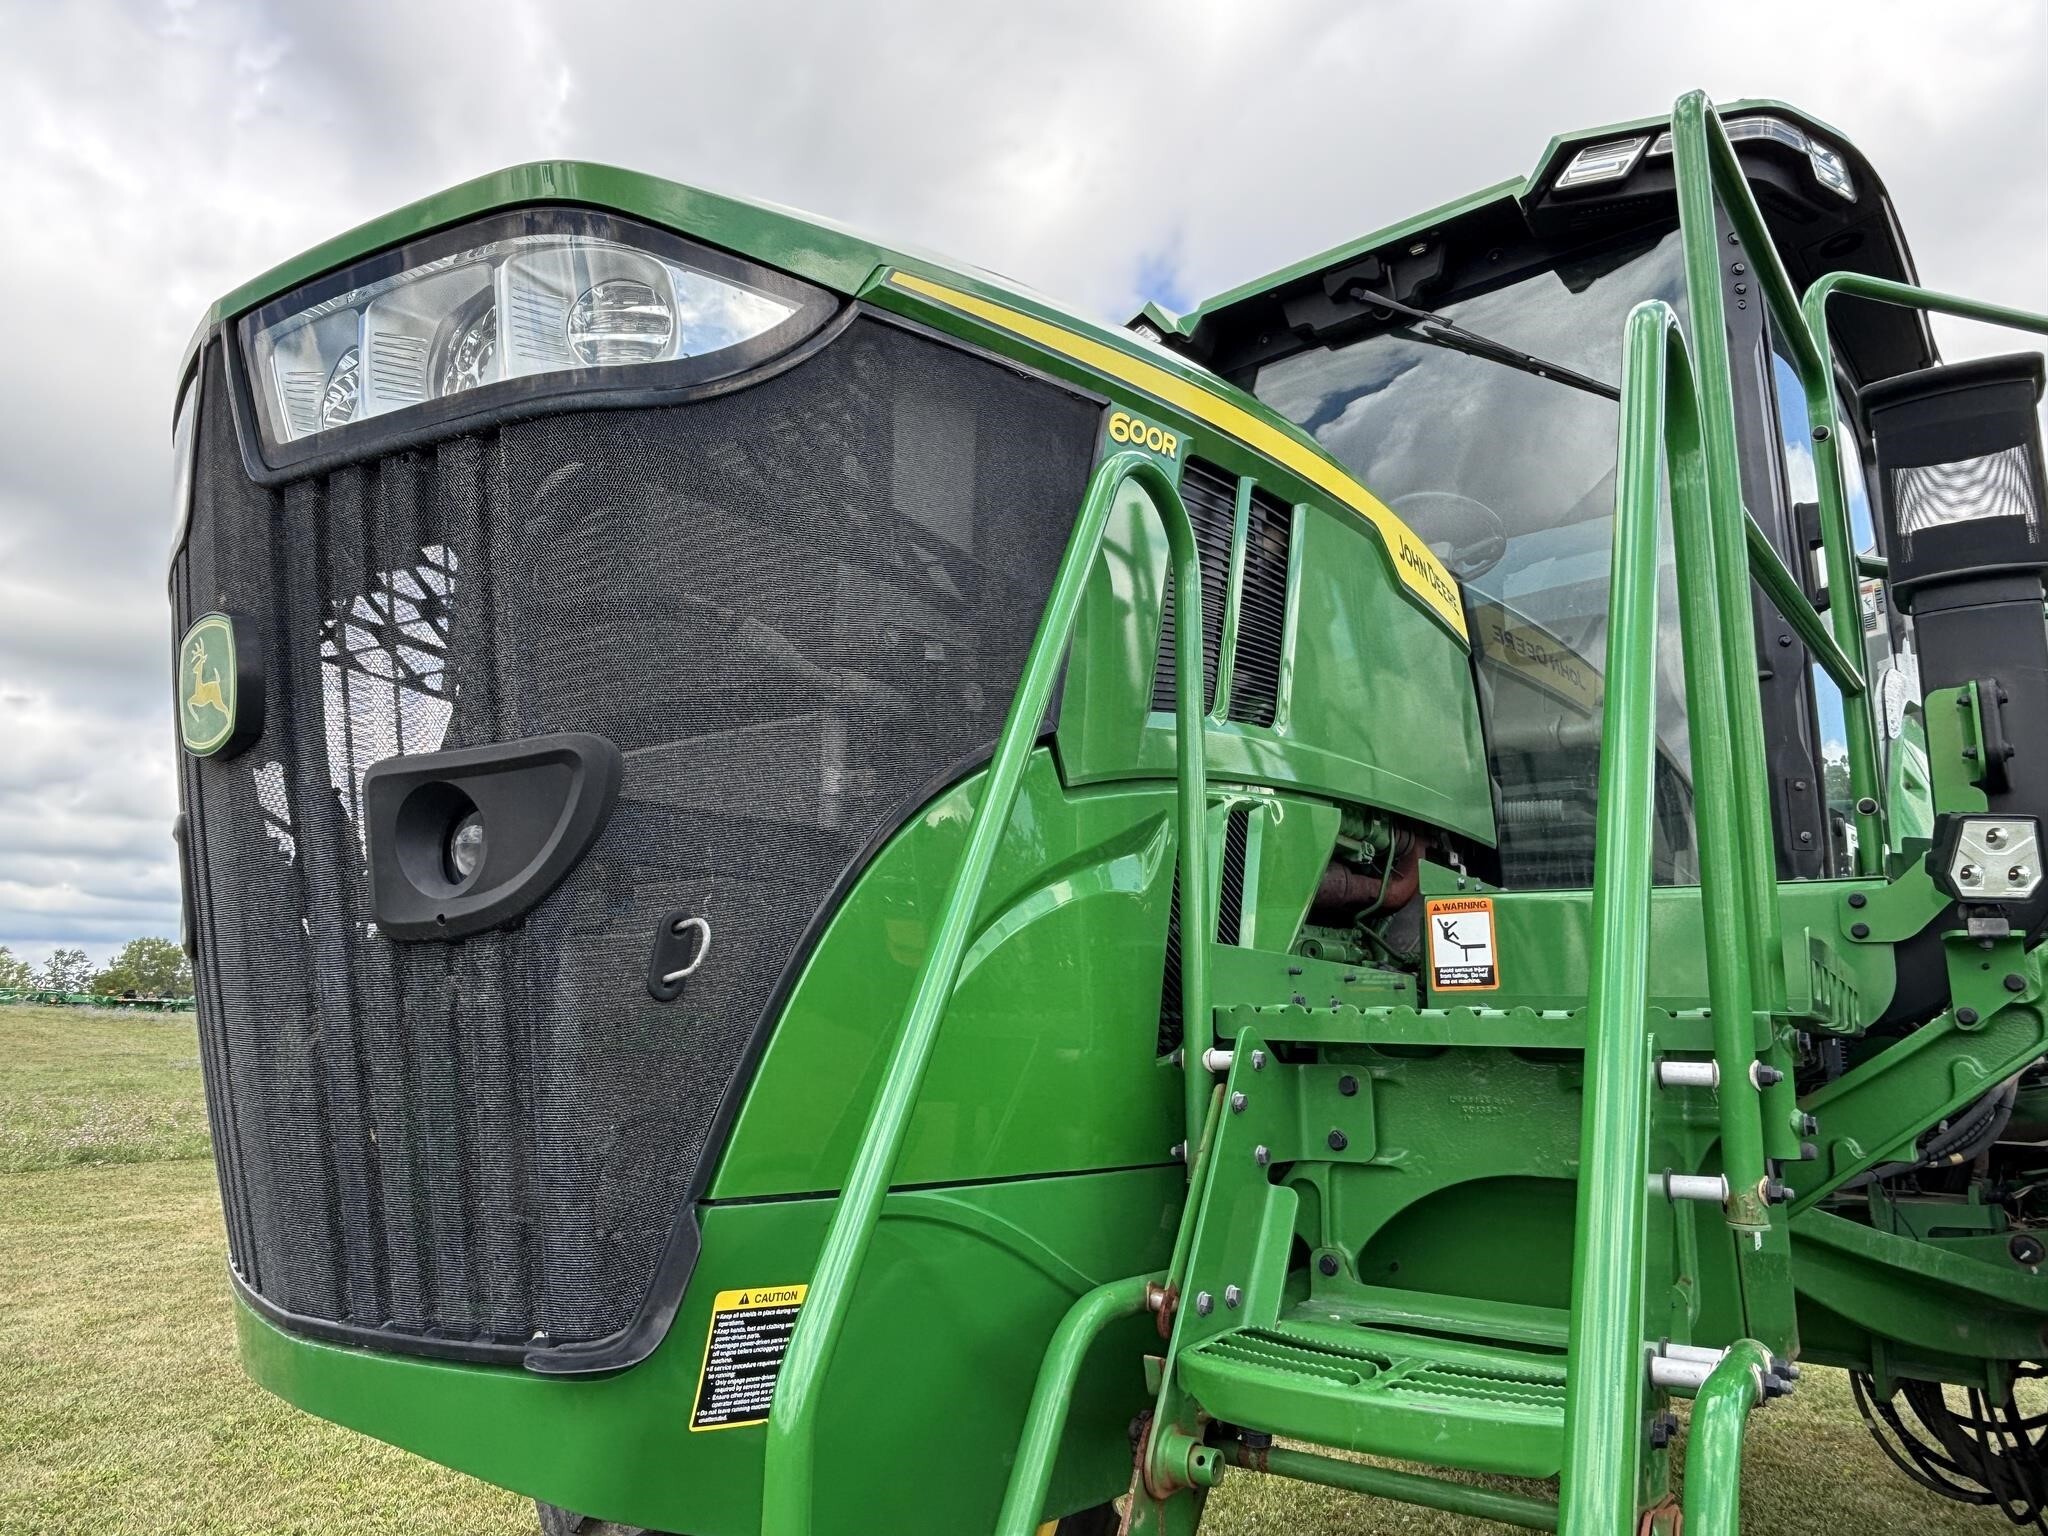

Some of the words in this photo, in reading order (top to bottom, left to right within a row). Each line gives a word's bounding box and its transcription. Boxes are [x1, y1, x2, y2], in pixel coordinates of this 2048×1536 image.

[1109, 412, 1177, 459] 600R
[1398, 534, 1429, 582] JOHN
[1426, 561, 1460, 616] DEERE
[1442, 900, 1488, 911] WARNING
[754, 1290, 798, 1303] CAUTION
